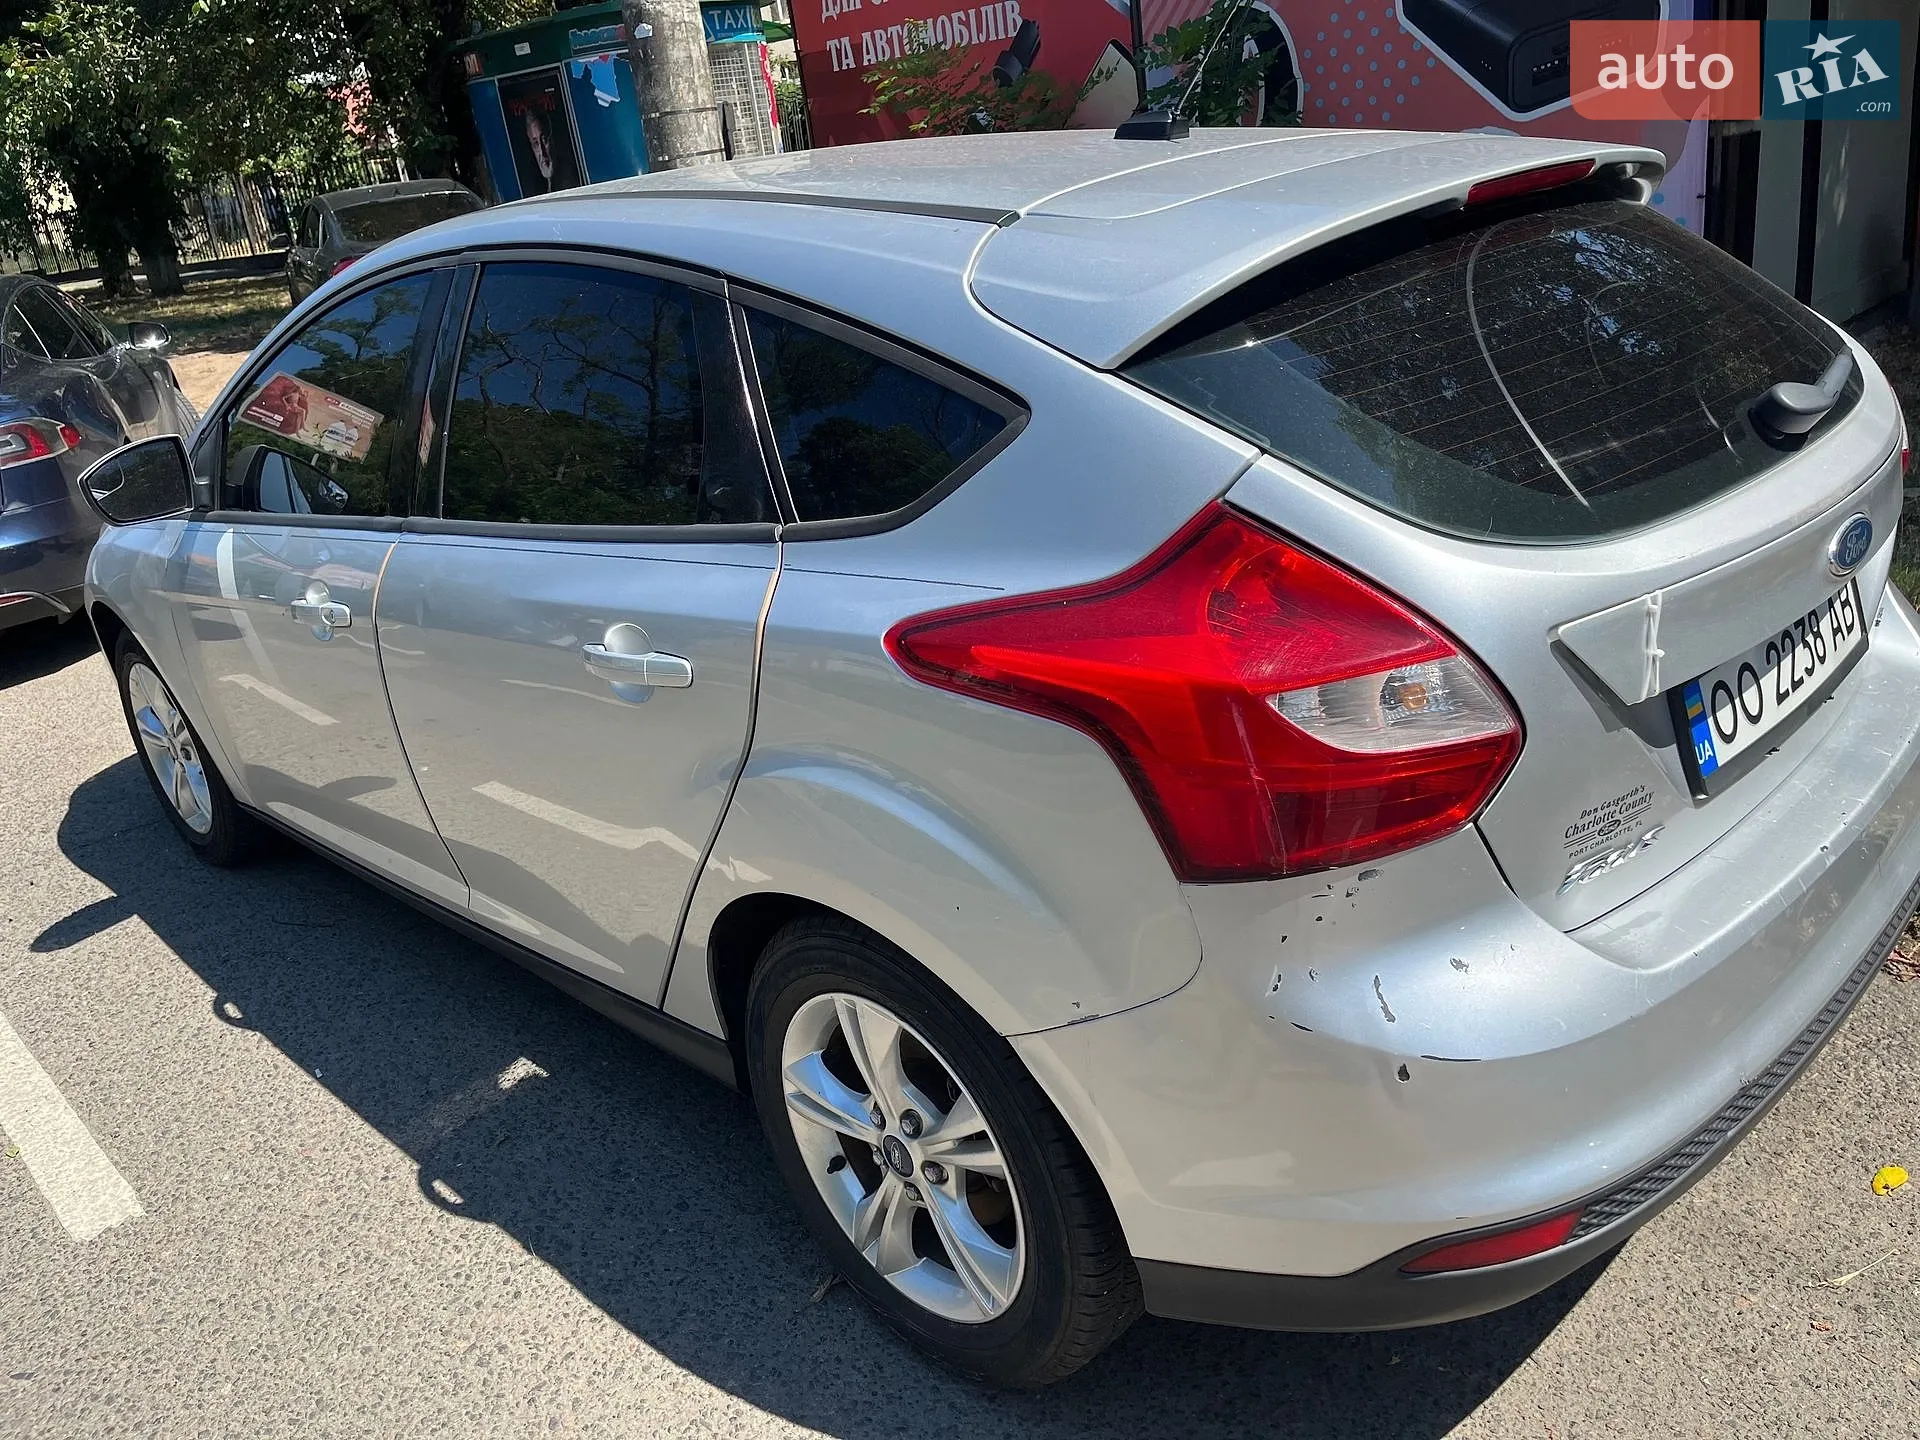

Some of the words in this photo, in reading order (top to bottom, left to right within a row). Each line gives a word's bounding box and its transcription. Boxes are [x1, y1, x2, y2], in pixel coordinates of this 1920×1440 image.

[826, 36, 856, 72] ТА
[1710, 661, 1763, 744] OO
[1766, 608, 1827, 707] 2238
[1826, 583, 1856, 652] AB
[1694, 741, 1713, 765] UA
[1564, 809, 1617, 839] Charlotte
[1618, 791, 1655, 815] County
[1580, 806, 1599, 820] Don
[1568, 844, 1589, 859] PORT
